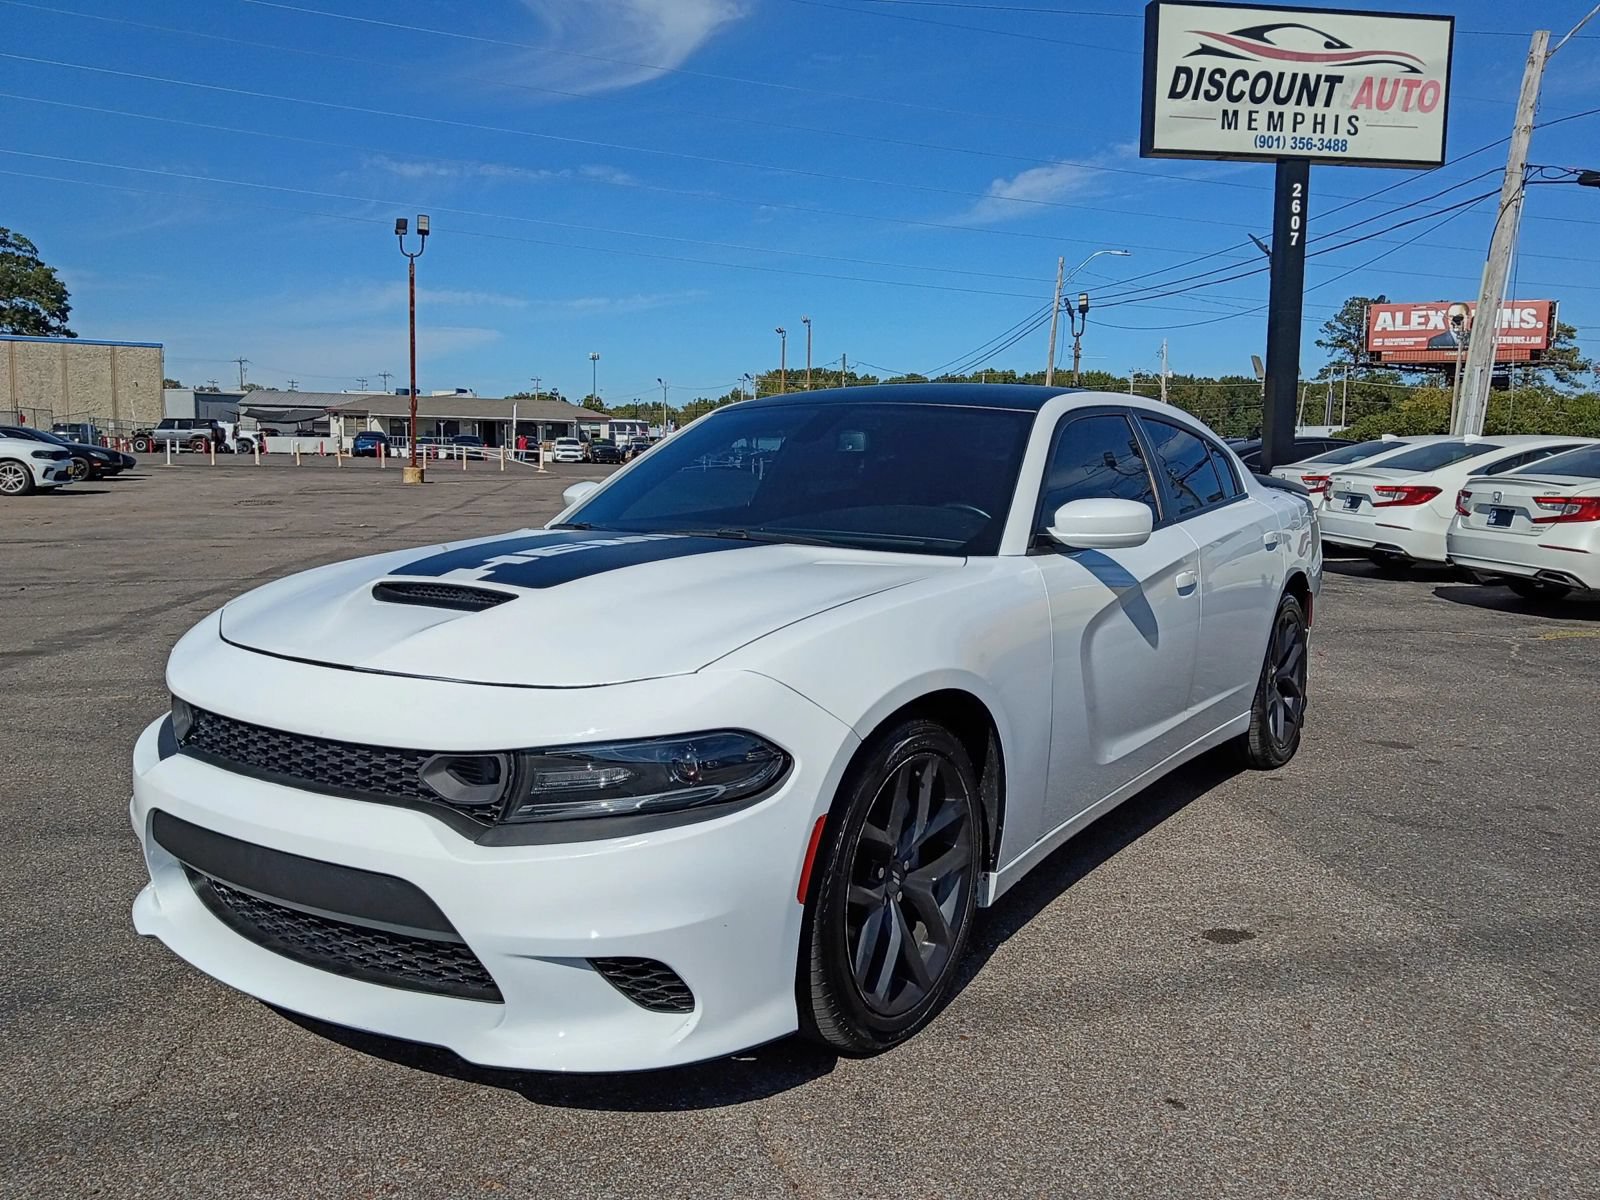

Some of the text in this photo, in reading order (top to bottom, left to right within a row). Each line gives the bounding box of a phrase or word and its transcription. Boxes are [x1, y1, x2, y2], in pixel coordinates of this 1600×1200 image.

[1168, 66, 1441, 113] DISCOUNT AUTO
[1221, 110, 1360, 136] MEMPHIS
[1254, 134, 1348, 153] (901) 356-3488
[1290, 183, 1302, 246] 2607
[1374, 308, 1544, 331] ALEX INS.
